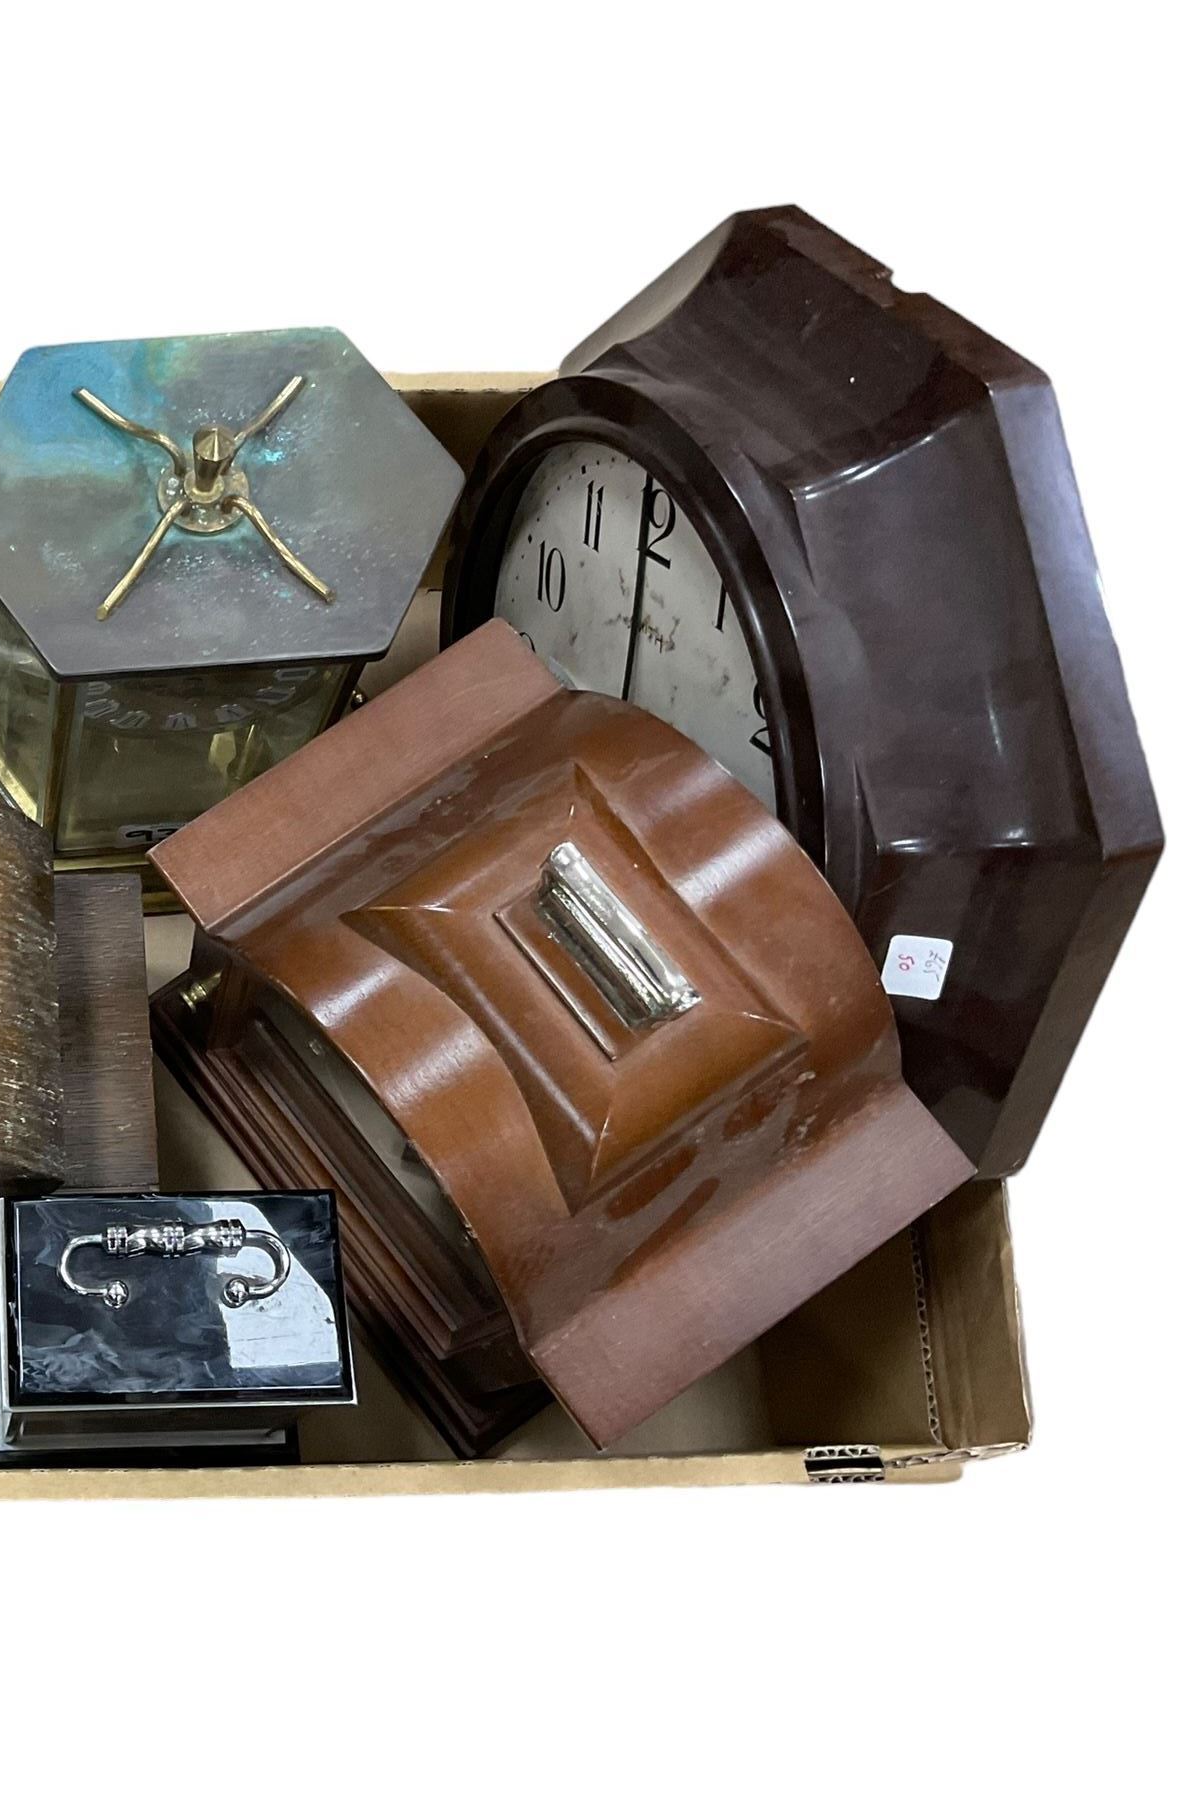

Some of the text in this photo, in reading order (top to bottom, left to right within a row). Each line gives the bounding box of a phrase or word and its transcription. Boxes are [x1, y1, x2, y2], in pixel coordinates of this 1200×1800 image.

[582, 480, 604, 553] 11
[537, 540, 567, 613] 10
[898, 953, 915, 972] 50
